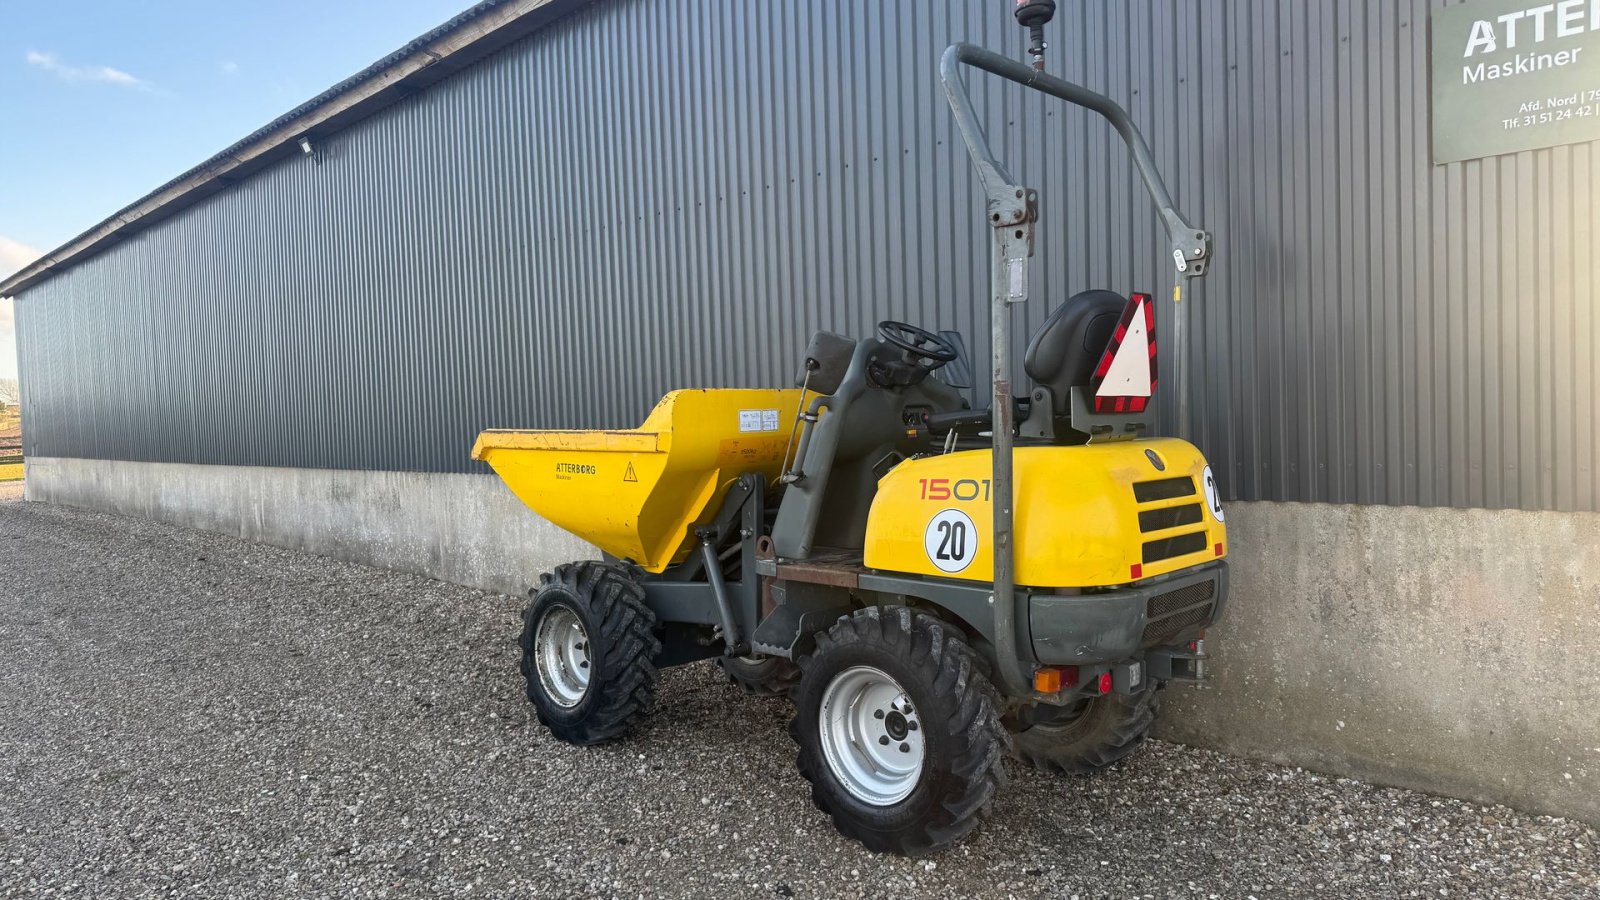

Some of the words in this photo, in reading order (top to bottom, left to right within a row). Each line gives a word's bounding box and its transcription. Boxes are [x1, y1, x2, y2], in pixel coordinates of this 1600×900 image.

[1463, 47, 1582, 85] Maskiner
[1519, 101, 1543, 114] Afd.
[1547, 94, 1577, 108] Nord
[1502, 117, 1520, 130] Tlf.
[1524, 115, 1536, 126] 31
[1540, 112, 1552, 123] 51
[1556, 109, 1571, 120] 24
[1576, 106, 1592, 116] 42
[556, 462, 596, 475] ATTERBORG
[919, 478, 991, 501] 1501
[1207, 476, 1223, 512] 2
[936, 520, 966, 561] 20
